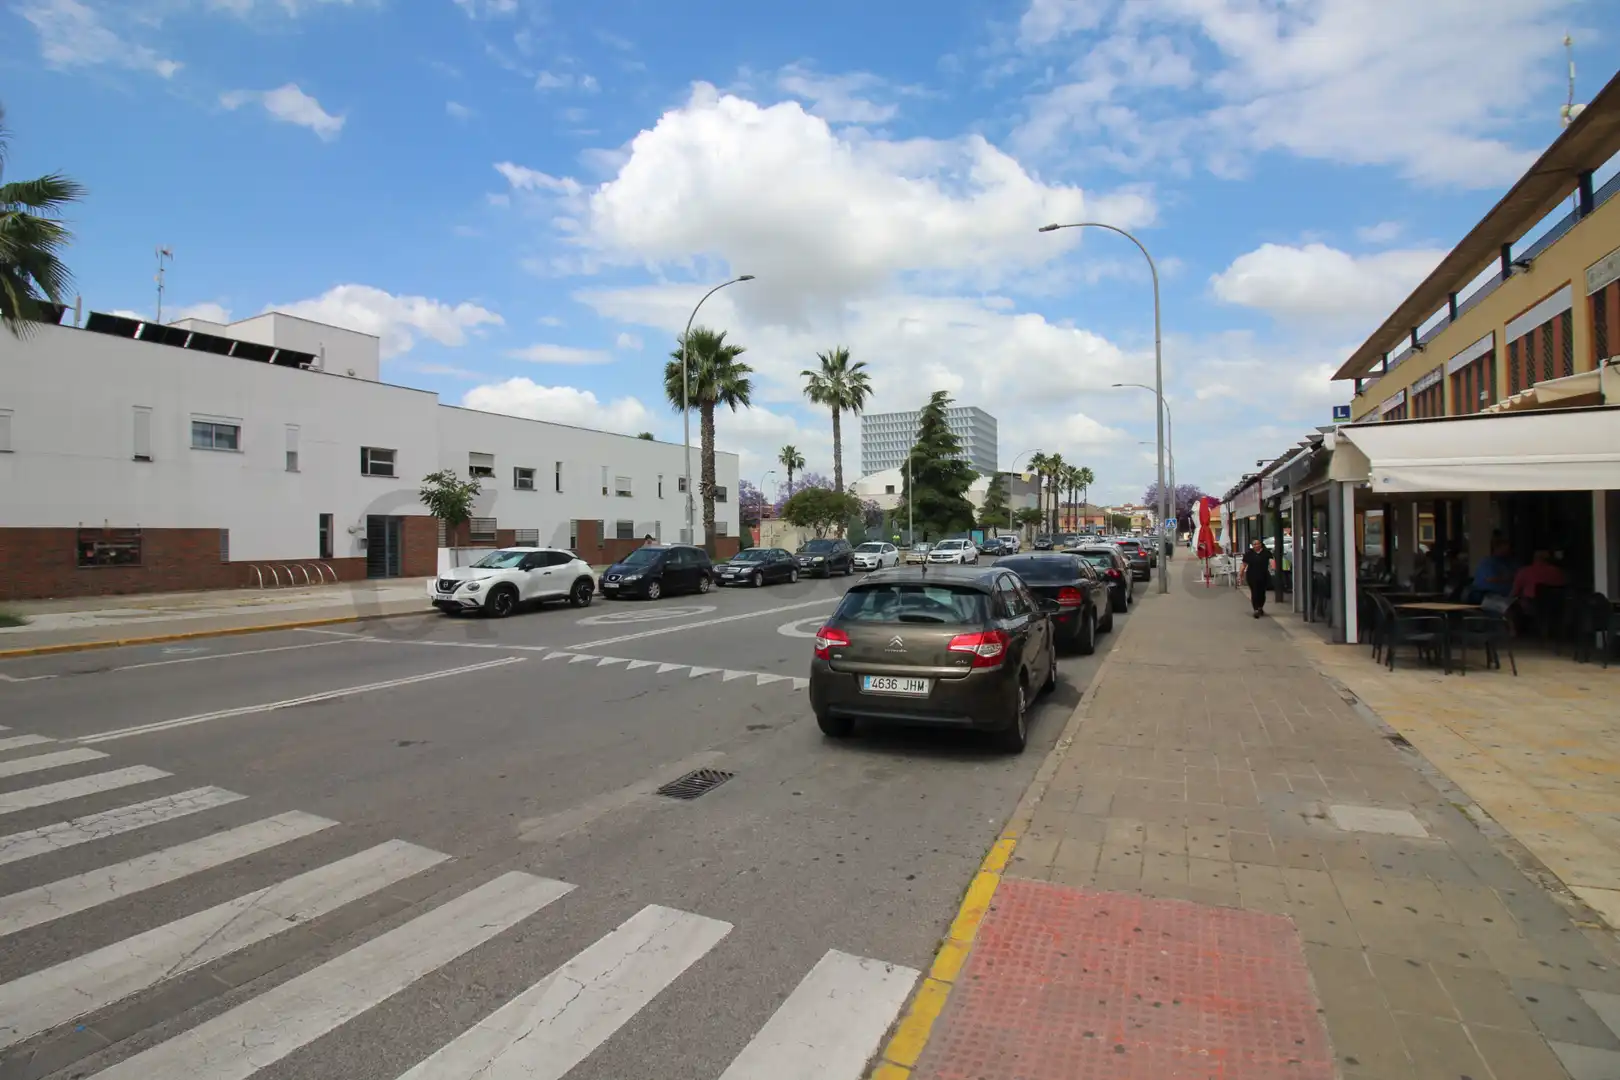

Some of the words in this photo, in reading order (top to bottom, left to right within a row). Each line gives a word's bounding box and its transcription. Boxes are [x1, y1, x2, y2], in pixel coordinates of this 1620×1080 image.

[1337, 407, 1346, 417] L
[872, 678, 898, 690] 4636
[903, 680, 925, 691] JHM
